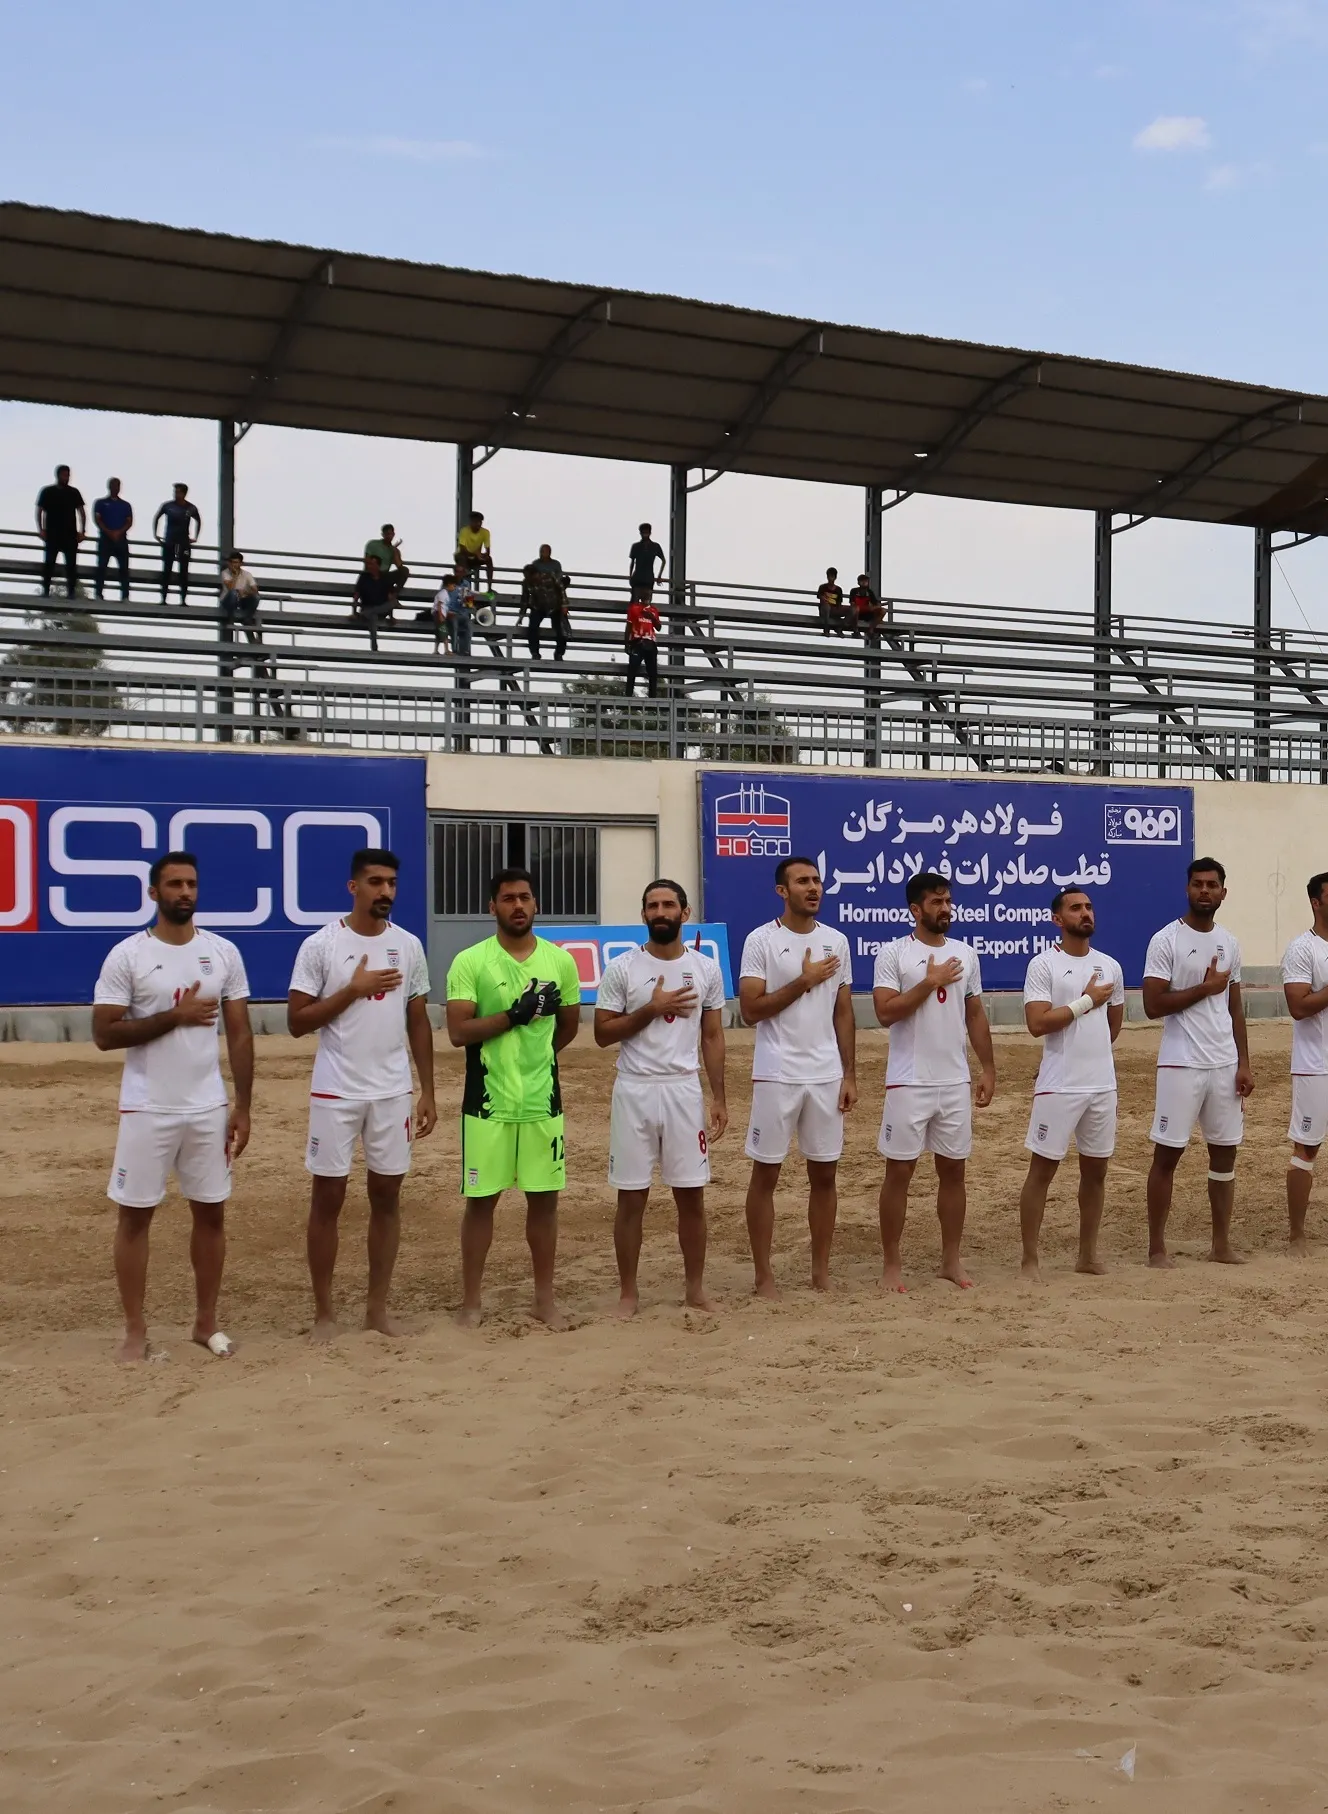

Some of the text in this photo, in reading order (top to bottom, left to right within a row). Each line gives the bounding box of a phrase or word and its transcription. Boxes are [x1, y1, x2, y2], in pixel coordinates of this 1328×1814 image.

[842, 798, 1063, 846] فولاد هرمزگان
[716, 838, 792, 857] HOSCO
[817, 850, 885, 895] ایرا
[954, 852, 1049, 895] صادرات
[1051, 852, 1112, 893] قطب
[839, 903, 1053, 928] Hormozg Steel Compa
[972, 935, 1029, 959] Export
[697, 1129, 707, 1155] 8
